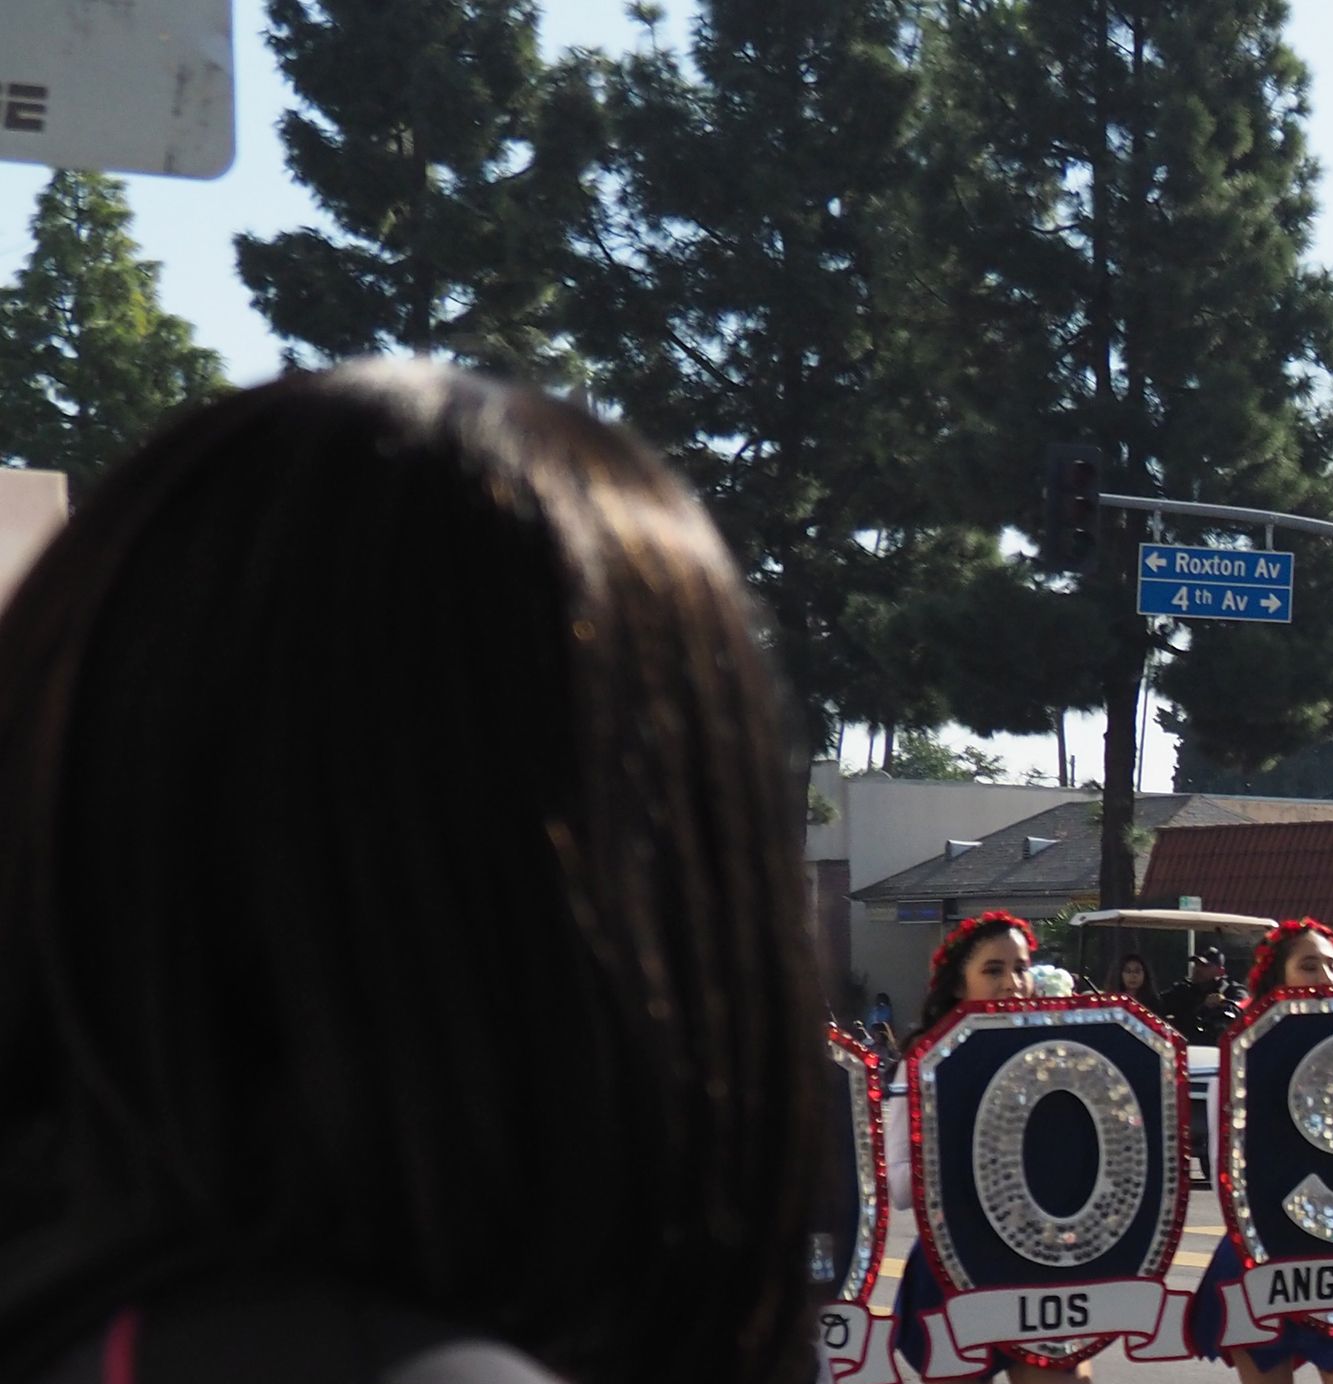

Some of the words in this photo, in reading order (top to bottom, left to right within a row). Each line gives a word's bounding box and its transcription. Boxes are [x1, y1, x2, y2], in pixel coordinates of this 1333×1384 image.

[1174, 552, 1246, 577] Roxton
[1254, 557, 1281, 579] Av
[1171, 586, 1213, 611] 4th
[1221, 589, 1248, 611] Av
[972, 1039, 1148, 1267] O
[1018, 1293, 1090, 1333] LOS
